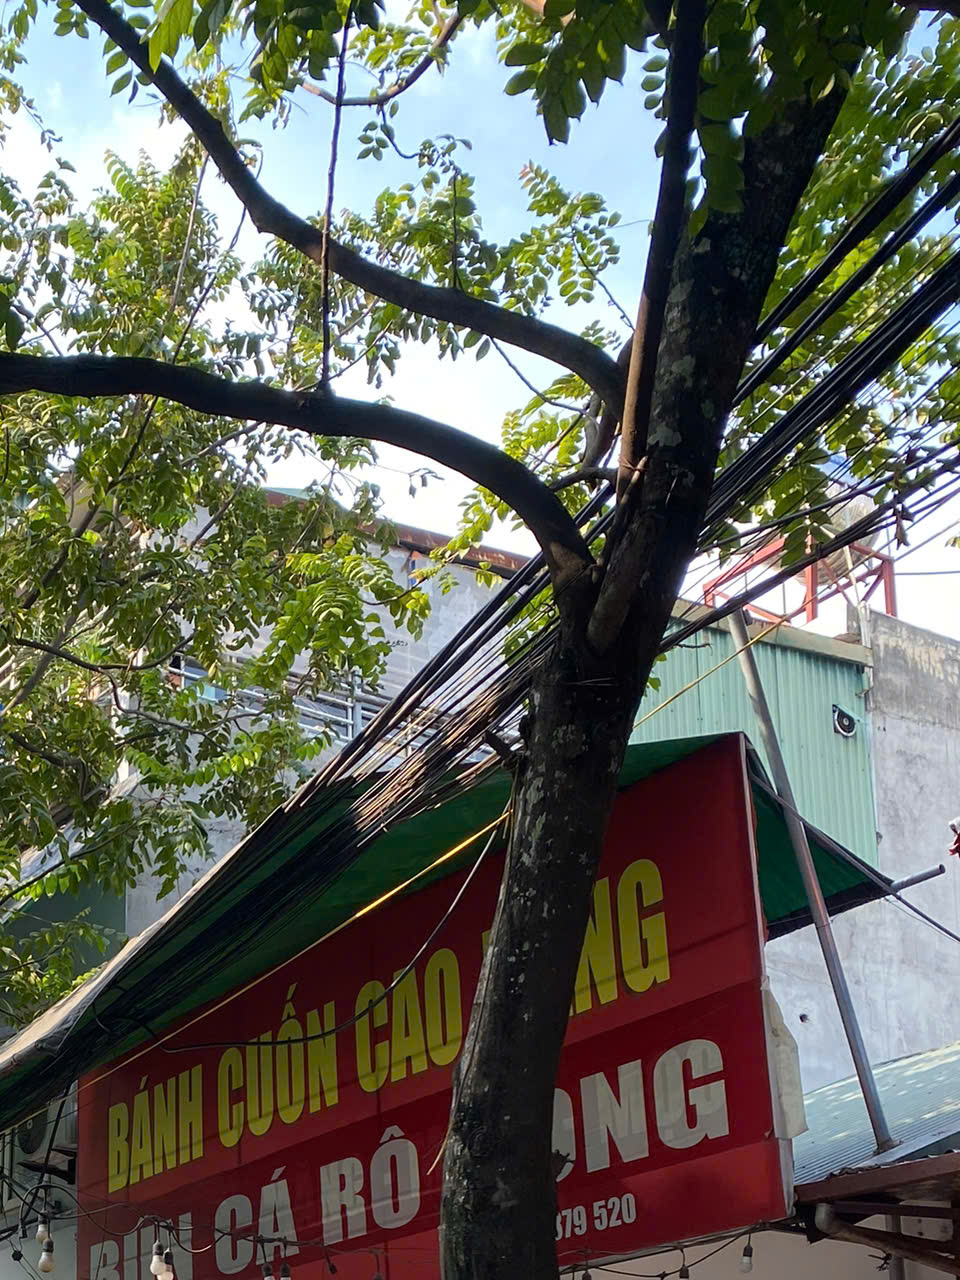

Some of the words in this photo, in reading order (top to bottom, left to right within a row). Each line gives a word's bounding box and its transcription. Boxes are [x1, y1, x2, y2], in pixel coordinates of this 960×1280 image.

[107, 1063, 204, 1194] BÁNH
[217, 983, 339, 1149] CUỐN
[354, 947, 464, 1094] CAO
[213, 1166, 299, 1275] CÁ
[319, 1125, 422, 1247] RÔ
[597, 1192, 643, 1232] 520
